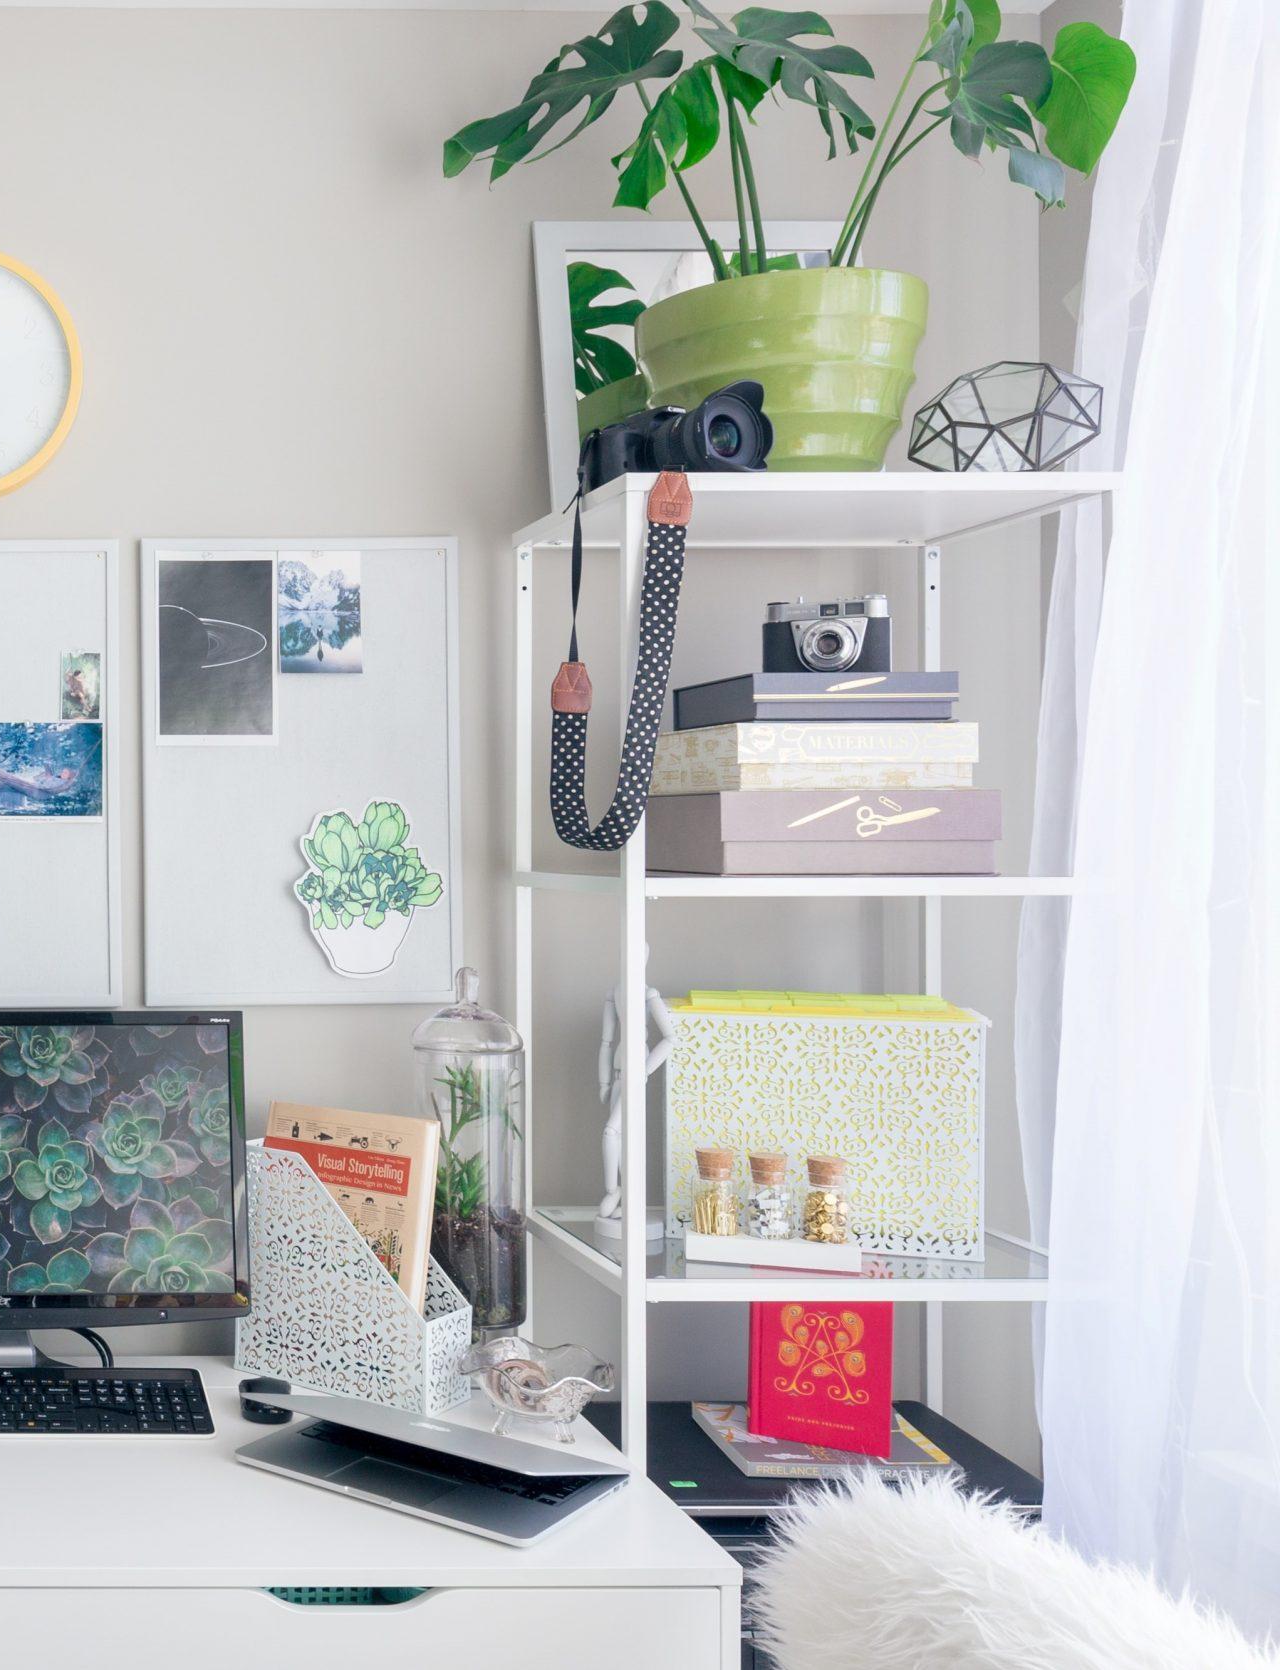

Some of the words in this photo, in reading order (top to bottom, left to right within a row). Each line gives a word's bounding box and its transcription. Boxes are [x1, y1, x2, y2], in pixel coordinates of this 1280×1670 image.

[23, 315, 42, 340] 2
[39, 361, 56, 385] 3
[25, 405, 43, 430] 4
[807, 734, 911, 751] MATERIALS
[317, 1153, 346, 1171] Visual
[348, 1158, 404, 1184] Storytelling
[384, 1182, 402, 1192] News
[756, 1465, 819, 1476] FREELANCE
